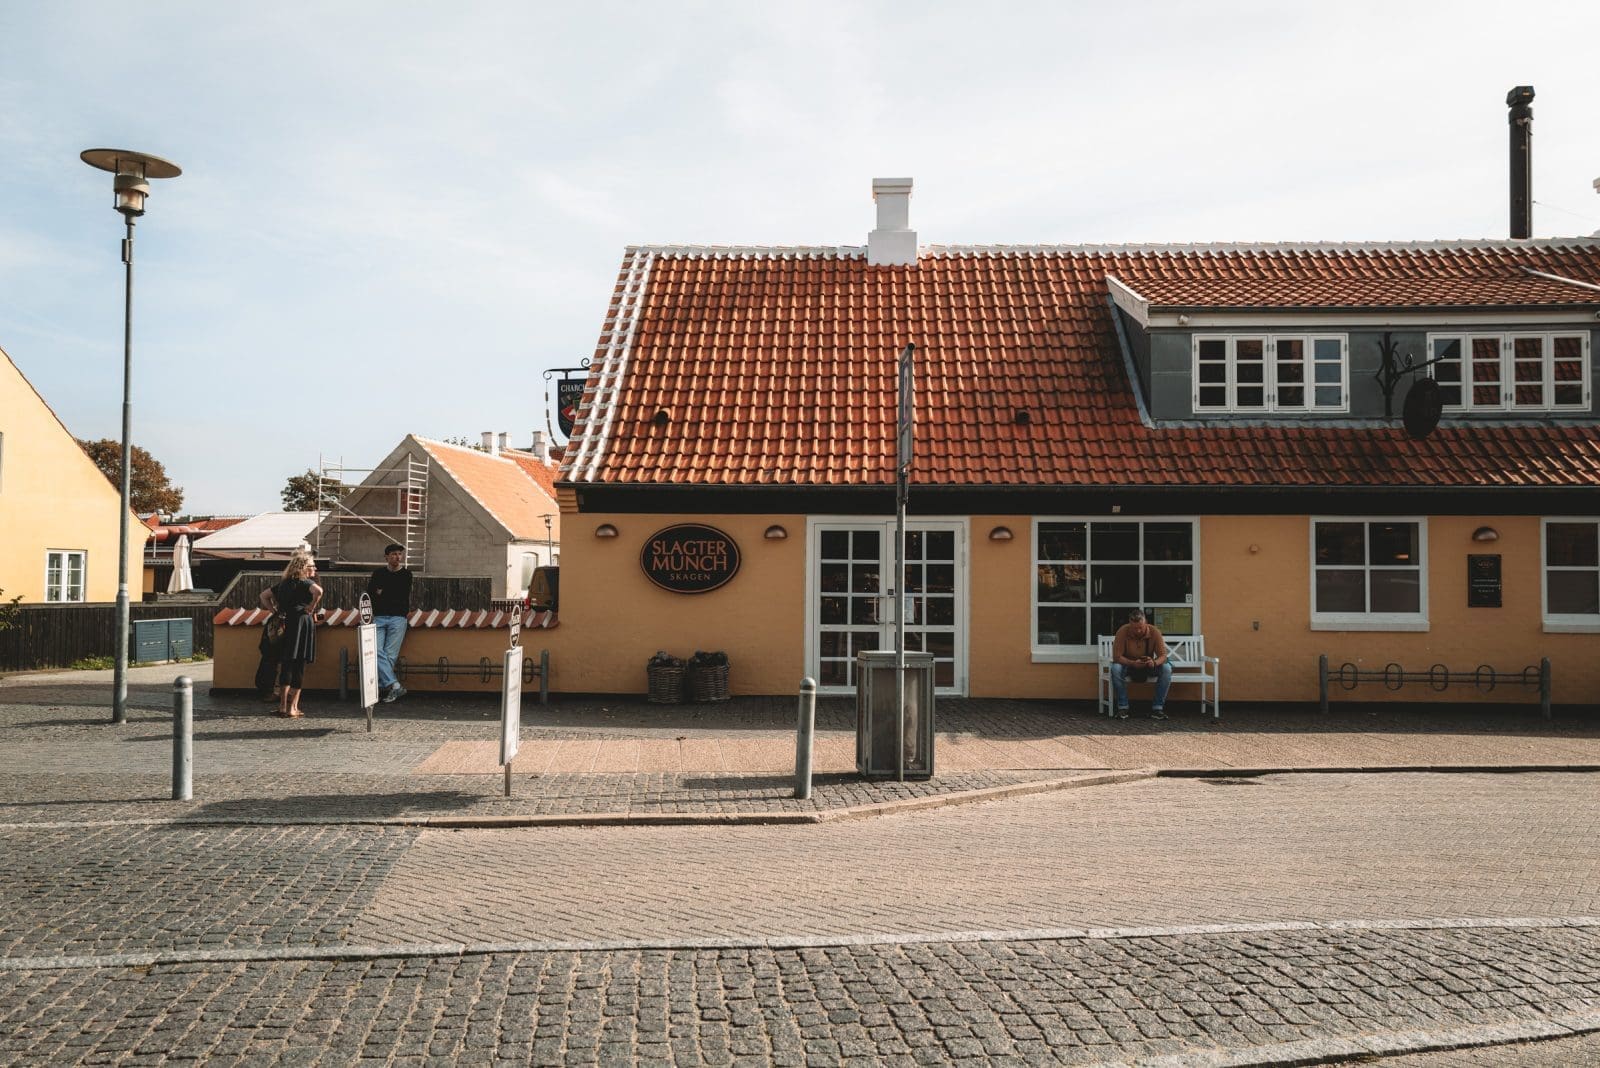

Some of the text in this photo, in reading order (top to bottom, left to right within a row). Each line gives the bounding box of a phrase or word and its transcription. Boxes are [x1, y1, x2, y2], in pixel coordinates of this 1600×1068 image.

[560, 384, 585, 393] CHARC
[652, 540, 727, 555] SLAGTER
[652, 555, 727, 571] MUNCH
[670, 573, 711, 581] SKAGEN
